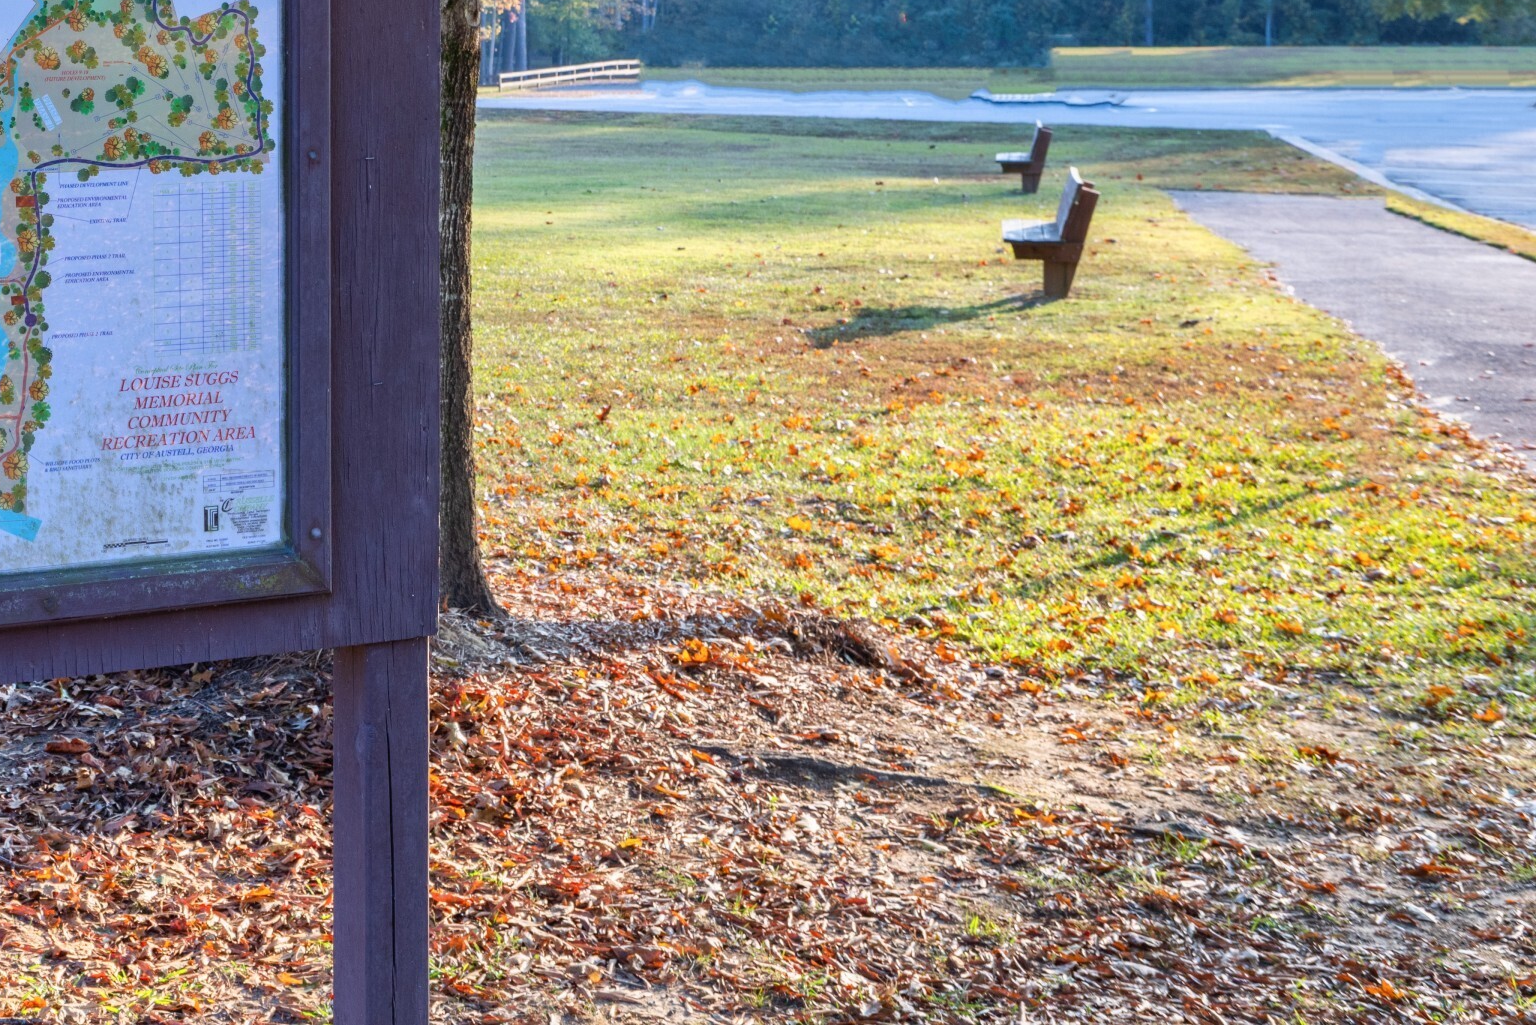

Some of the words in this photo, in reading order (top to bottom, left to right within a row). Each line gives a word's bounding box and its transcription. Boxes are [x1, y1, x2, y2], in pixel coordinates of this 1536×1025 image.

[119, 375, 182, 392] LOUISE
[184, 370, 239, 387] SUGGS
[133, 391, 224, 410] MEMORIAL
[127, 408, 233, 430] COMMUNITY
[100, 429, 211, 451] RECREATION
[212, 425, 257, 442] AREA
[120, 452, 142, 461] CITY
[141, 451, 153, 459] OF
[155, 448, 195, 458] AUSTELL,
[196, 444, 234, 454] GEORGIA
